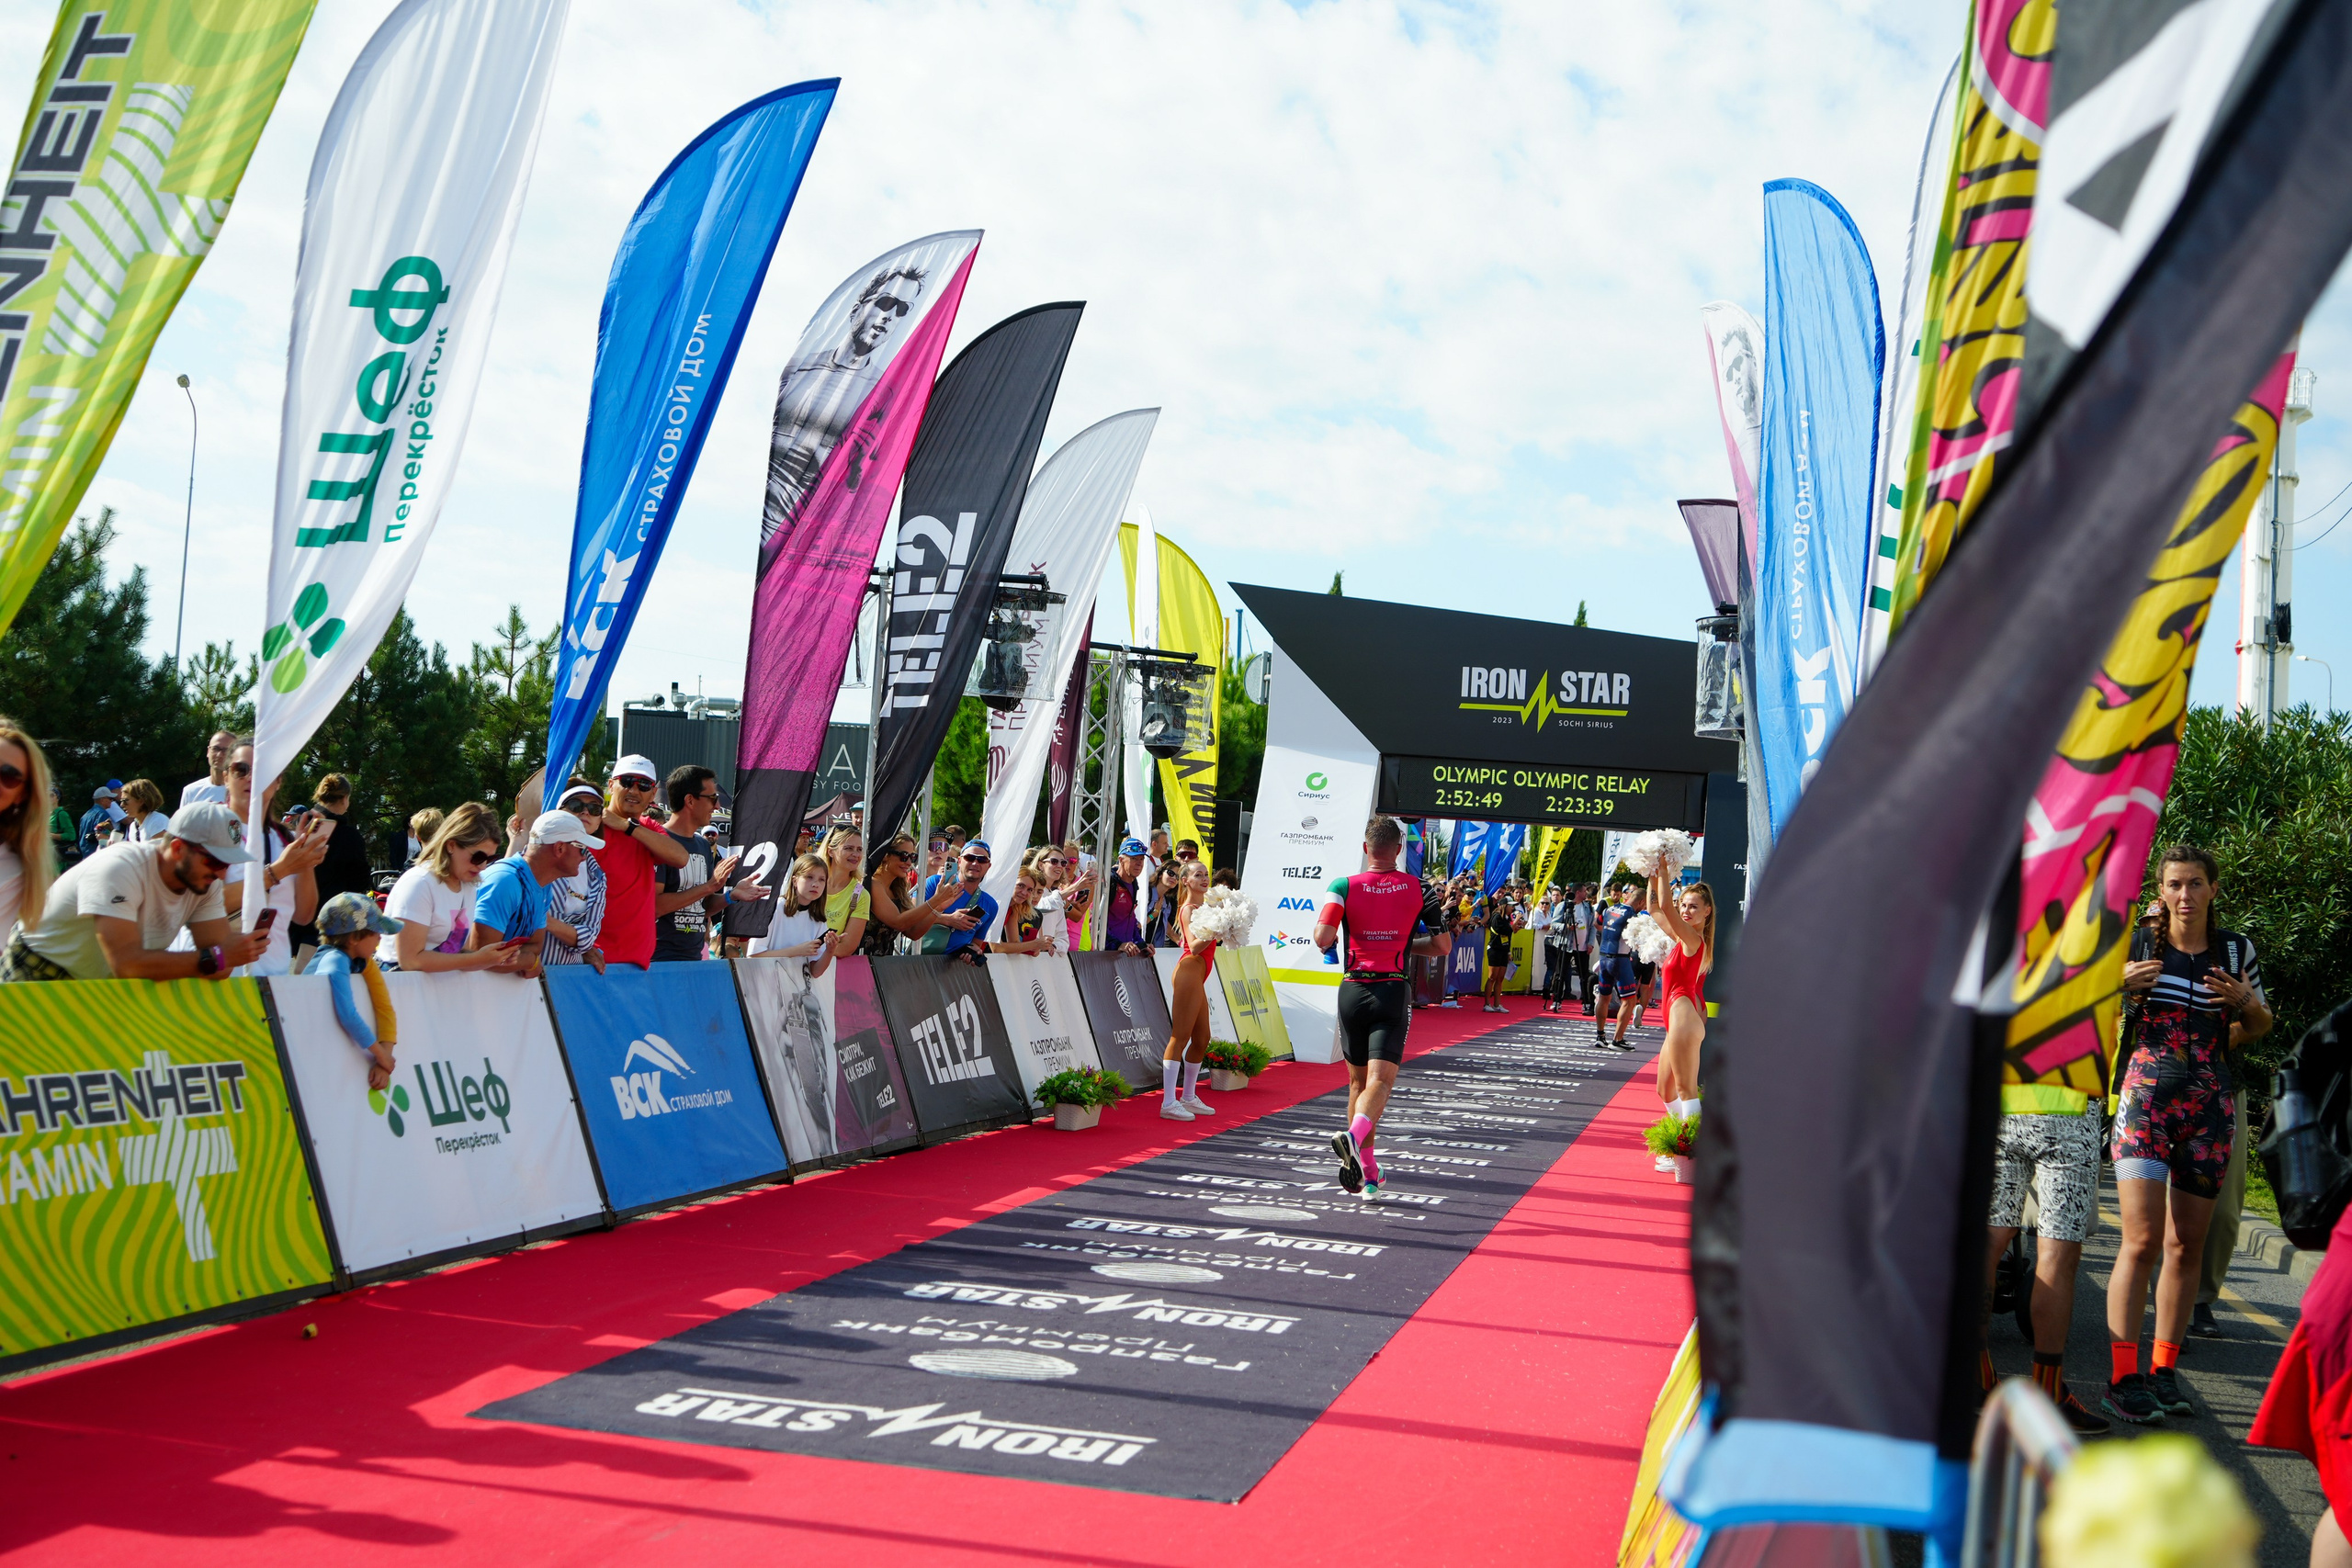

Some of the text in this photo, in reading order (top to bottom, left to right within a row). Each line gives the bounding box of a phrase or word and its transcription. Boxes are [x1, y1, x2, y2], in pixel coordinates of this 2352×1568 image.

[0, 13, 134, 402] NHEIT
[294, 255, 450, 548] Шеф
[382, 326, 449, 544] Перекрёсток
[635, 312, 712, 543] СТРАХОВОЙ ДОМ
[566, 547, 640, 700] ВСК
[879, 512, 978, 717] TELE2
[1461, 666, 1631, 705] IRON STAR
[1558, 719, 1584, 728] SOCHI
[833, 781, 862, 792] FOO
[1433, 765, 1650, 795] OLYMPIC OLYMPIC RELAY
[1297, 791, 1330, 799] Сириус
[1435, 788, 1614, 816] 2:52:49 2:23:39
[1280, 832, 1334, 841] ГАЗПРОМБАНК
[1282, 865, 1322, 880] TELE2
[1362, 882, 1408, 895] Tatarstan
[1277, 897, 1315, 911] AVA
[1290, 936, 1311, 945] сбп
[1454, 946, 1476, 973] AVA
[2226, 941, 2239, 974] IRONSTAR
[910, 994, 996, 1086] TELE2
[1030, 1035, 1073, 1056] ГАЗПРОМБАНК
[1114, 1028, 1153, 1045] ГАЗПРОМБАНК
[843, 1056, 876, 1084] КАК БЕЖИТ
[0, 1061, 246, 1137] HRENHEIT
[413, 1057, 511, 1134] Шеф
[611, 1069, 673, 1120] ВСК
[670, 1089, 733, 1113] СТРАХОВОЙ ДОМ
[876, 1084, 896, 1109] TELE2
[435, 1130, 502, 1155] Перекрёсток
[0, 1140, 114, 1205] AMIN
[1396, 1154, 1488, 1167] IRON
[1176, 1175, 1287, 1190] STAR
[1066, 1219, 1388, 1257] IRON STAR
[903, 1285, 1290, 1335] IRON STAR
[831, 1320, 1251, 1371] Газпромбанк
[636, 1393, 1145, 1465] IRON STAR
